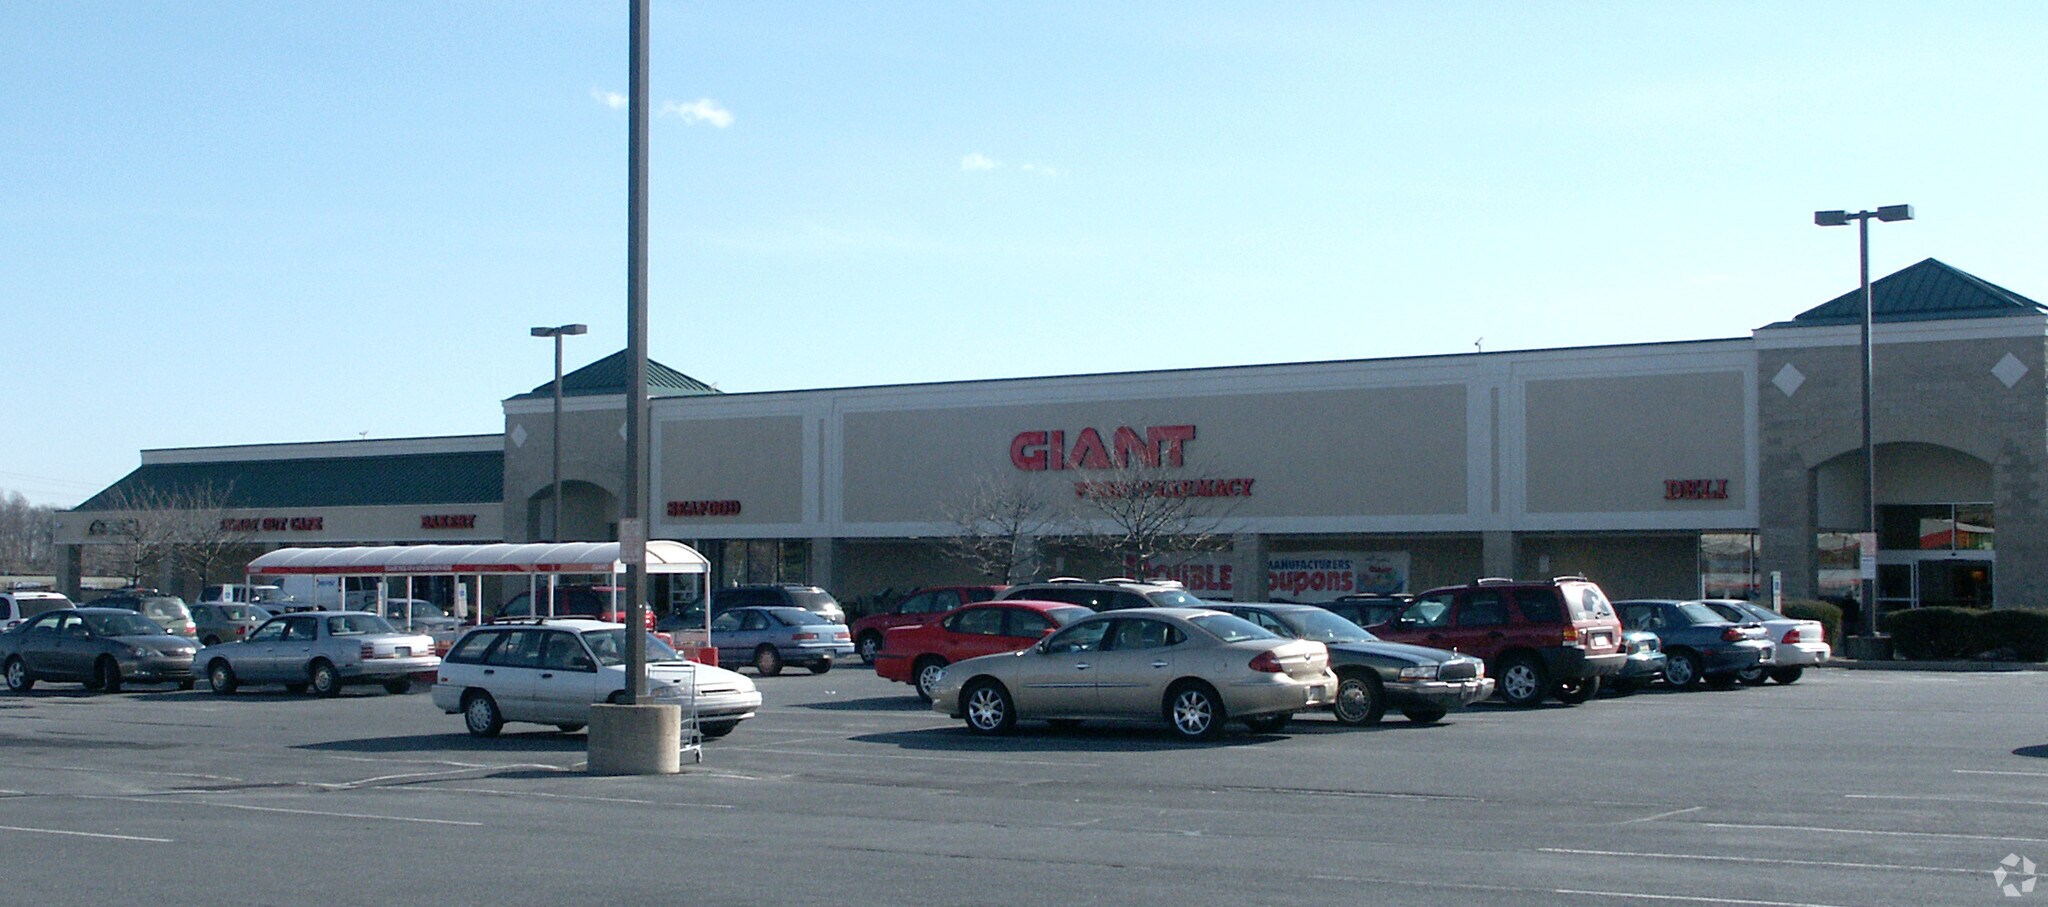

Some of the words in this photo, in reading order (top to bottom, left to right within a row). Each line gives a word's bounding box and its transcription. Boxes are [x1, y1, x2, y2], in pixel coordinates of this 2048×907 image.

[1010, 424, 1196, 471] GIANT
[1139, 478, 1255, 498] PHARMACY
[1664, 479, 1728, 500] DELI
[667, 500, 741, 516] SEAFOOD
[290, 516, 323, 531] CAFE
[421, 514, 476, 529] BAKERY
[1125, 554, 1232, 591] DOUBLE
[1267, 570, 1353, 596] oupons
